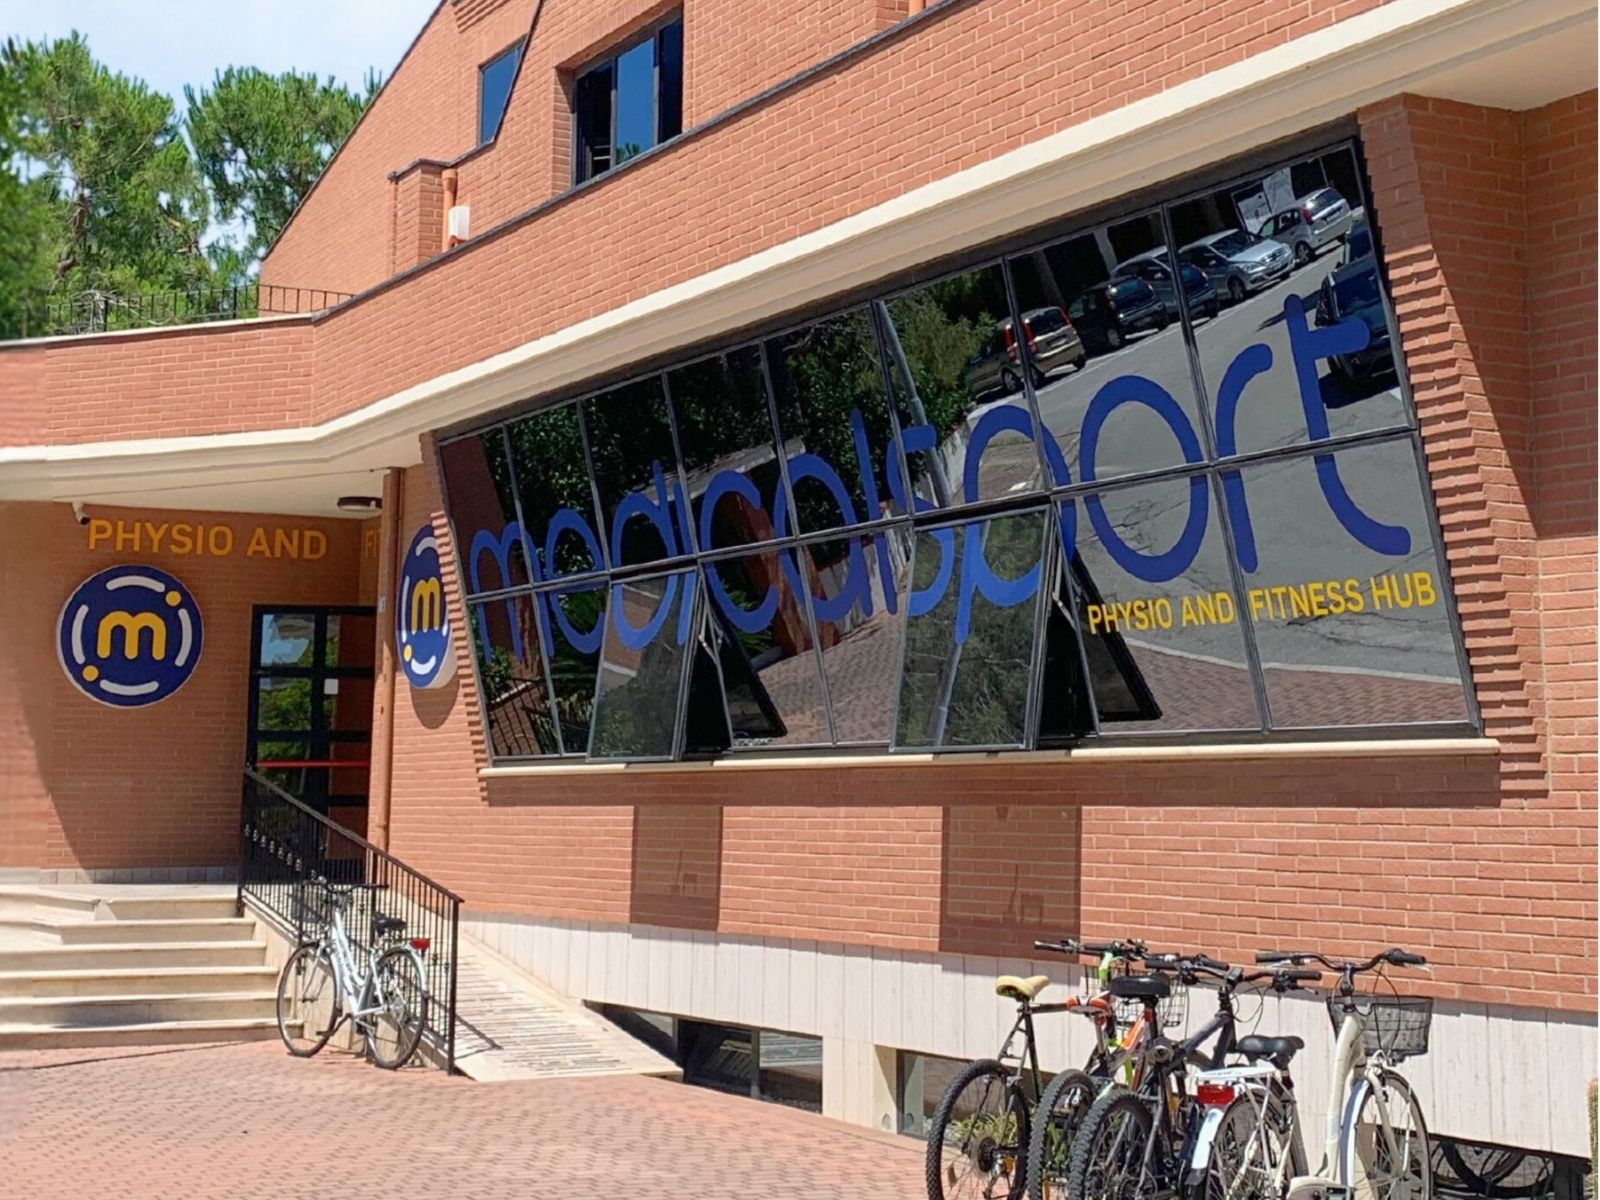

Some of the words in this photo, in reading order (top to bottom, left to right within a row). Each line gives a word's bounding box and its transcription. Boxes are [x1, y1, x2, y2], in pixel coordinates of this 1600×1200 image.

[470, 294, 1411, 665] medicalsport
[88, 519, 233, 556] PHYSIO
[246, 527, 327, 560] AND
[1087, 599, 1172, 634] PHYSIO
[1181, 592, 1234, 627] AND
[1249, 579, 1364, 622] FITNESS
[1370, 571, 1436, 610] HUB
[97, 611, 167, 661] m
